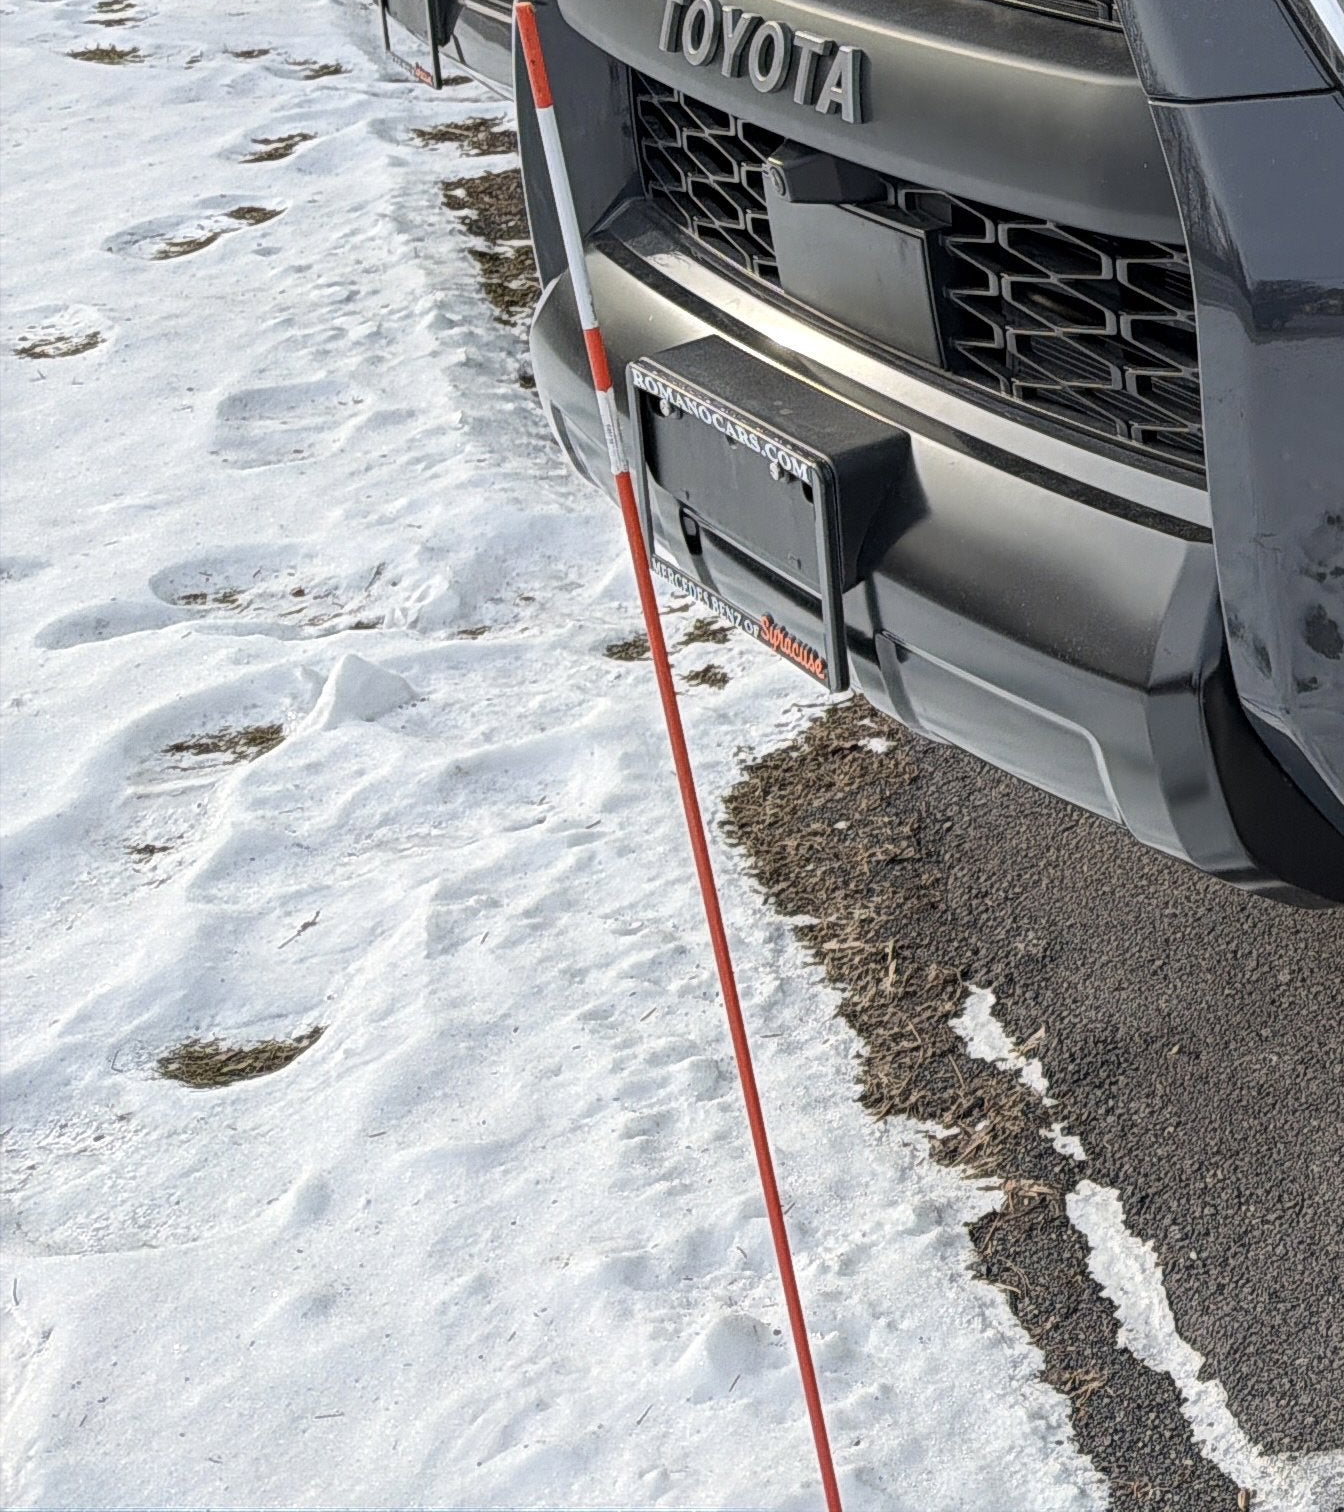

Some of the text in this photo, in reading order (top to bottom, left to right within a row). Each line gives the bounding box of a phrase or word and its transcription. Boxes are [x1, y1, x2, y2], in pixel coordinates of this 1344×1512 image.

[631, 368, 813, 485] ROMANOCARS.COM
[651, 557, 827, 680] MERCEDES BENZ OF Syracuse
